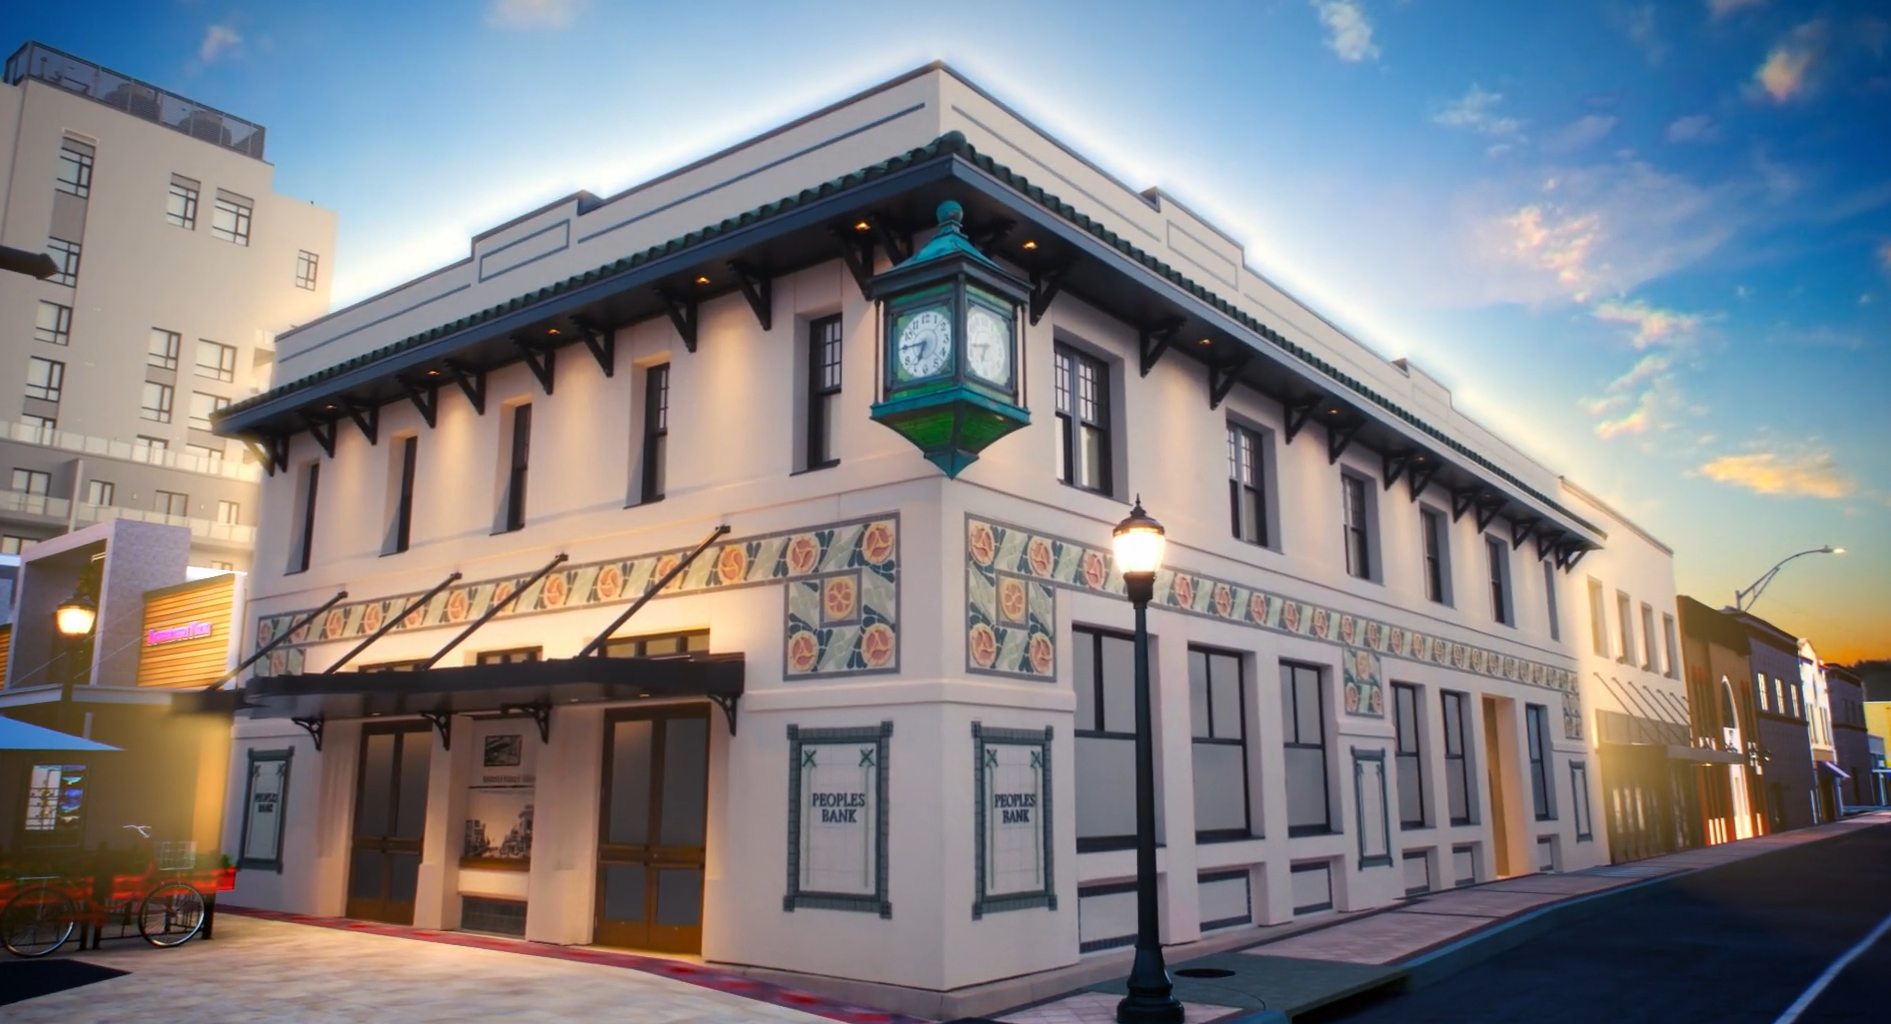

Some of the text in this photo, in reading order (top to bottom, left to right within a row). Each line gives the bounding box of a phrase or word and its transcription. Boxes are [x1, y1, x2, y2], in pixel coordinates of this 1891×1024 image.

[921, 313, 930, 324] 12
[912, 320, 919, 330] 11
[940, 321, 946, 331] 2
[943, 333, 950, 344] 3
[940, 346, 946, 357] 4
[933, 357, 940, 368] 5
[812, 792, 866, 807] PEOPLES
[994, 793, 1037, 808] PEOPLES
[822, 808, 857, 823] BANK
[1002, 808, 1030, 824] BANK
